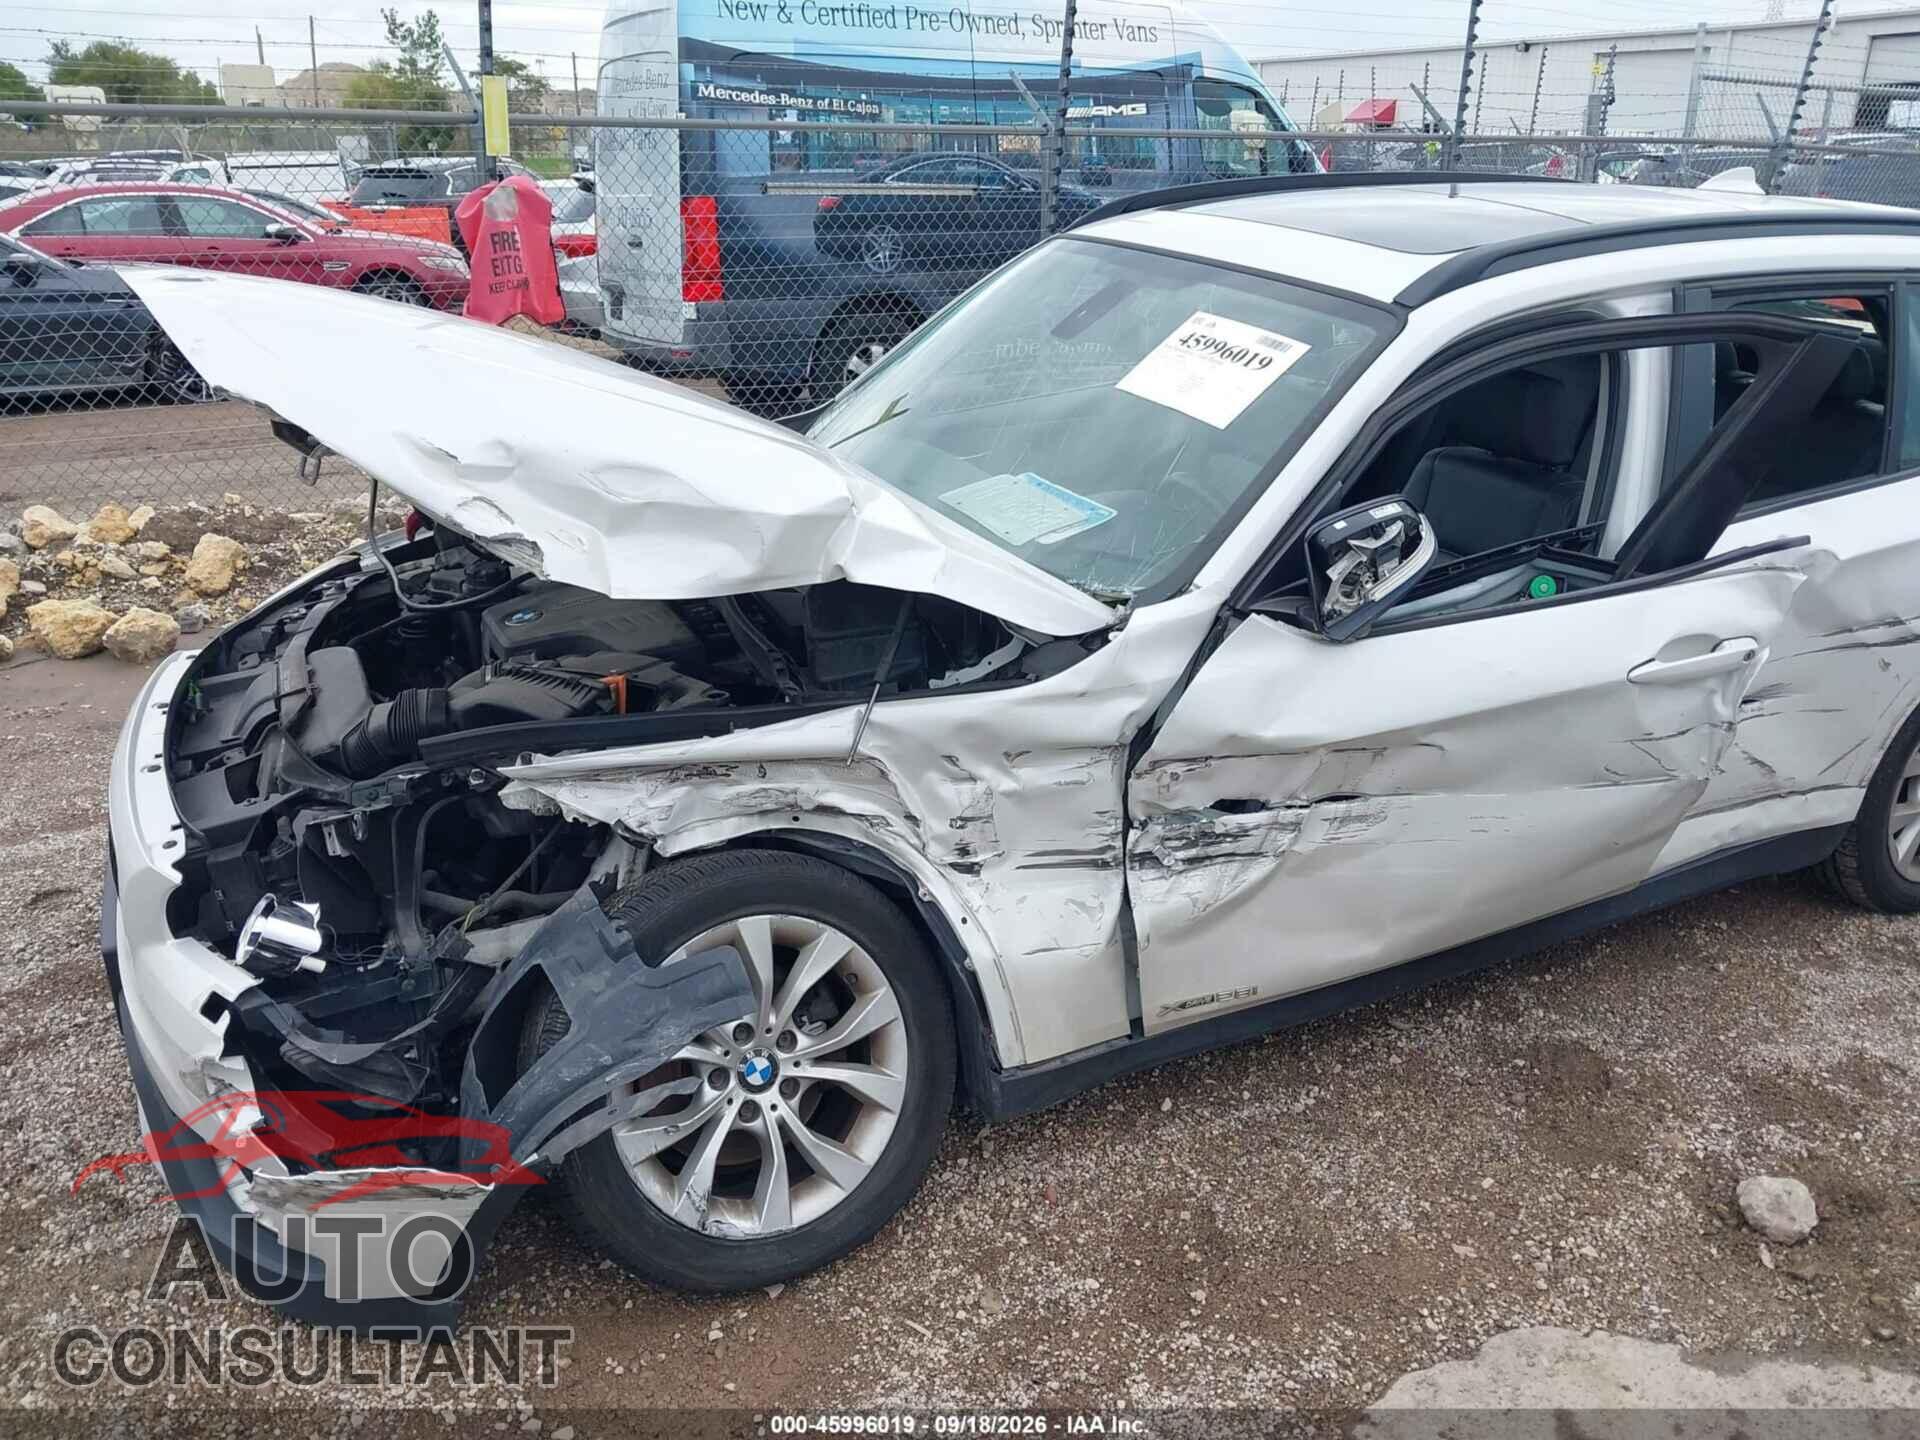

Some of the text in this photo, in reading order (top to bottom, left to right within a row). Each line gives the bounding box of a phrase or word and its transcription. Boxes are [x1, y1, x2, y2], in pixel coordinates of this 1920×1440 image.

[717, 0, 1158, 43] New & Certified Pre-Owned, Sprnter Vans
[697, 83, 880, 115] Mercedes-Benz of El Cajon
[1090, 103, 1147, 116] AMG
[1178, 332, 1274, 371] 45996019
